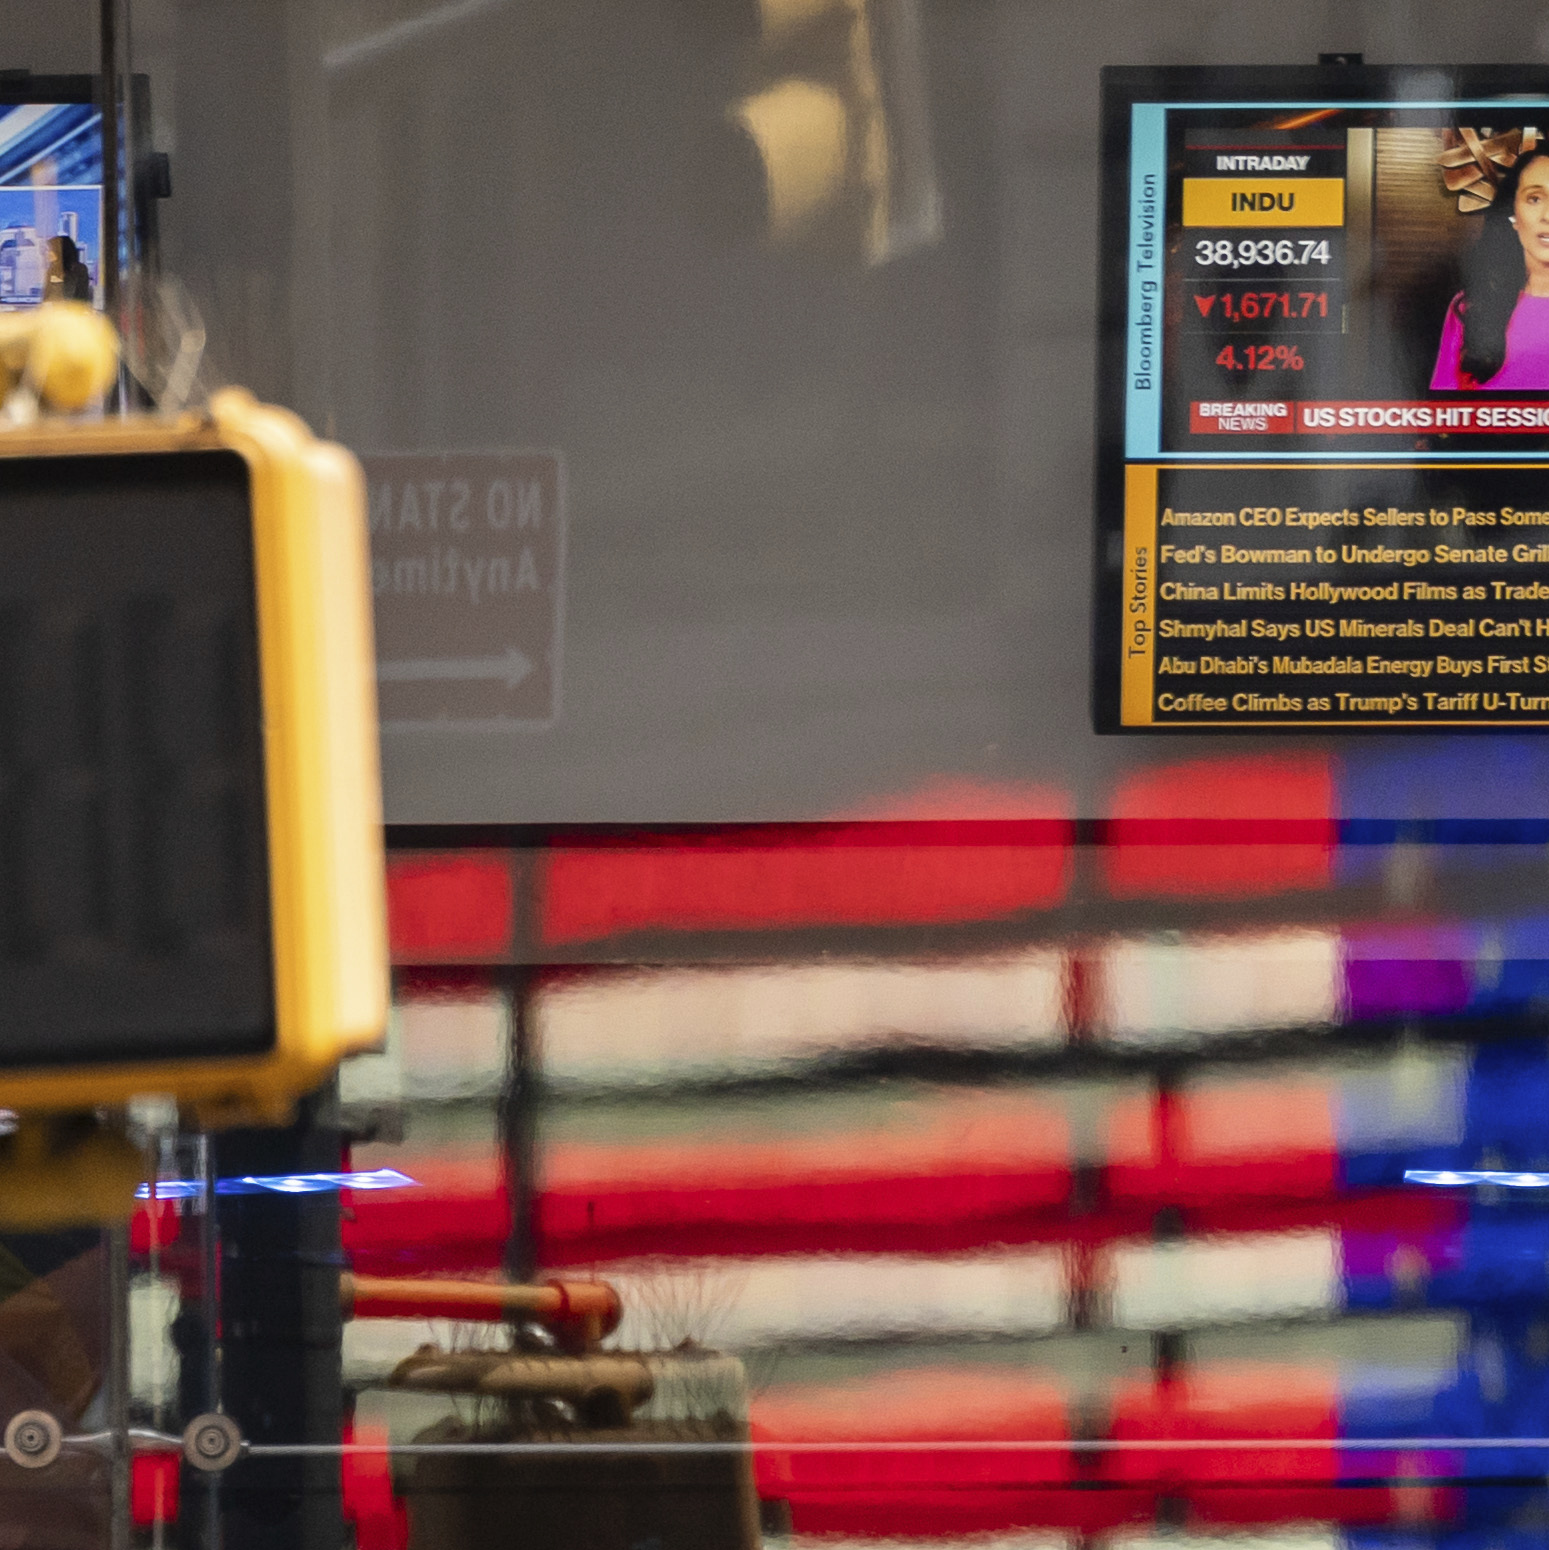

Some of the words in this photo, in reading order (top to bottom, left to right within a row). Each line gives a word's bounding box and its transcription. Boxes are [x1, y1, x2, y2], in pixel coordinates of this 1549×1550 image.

[1216, 155, 1309, 171] INTRADAY
[1231, 192, 1295, 212] INDU
[1136, 174, 1156, 272] Television
[1194, 240, 1331, 268] 38,936.74
[1222, 293, 1329, 321] 1,671.71
[1134, 280, 1158, 390] Bloomberg
[1216, 345, 1305, 371] 4.12%
[1199, 403, 1287, 417] BREAKING
[1303, 408, 1334, 427] US
[1339, 408, 1433, 427] STOCKS
[1435, 408, 1475, 427] HIT
[1217, 417, 1268, 431] NEWS
[1160, 508, 1236, 526] Amazon
[1239, 508, 1281, 526] CEO
[1285, 508, 1359, 529] Expects
[1363, 508, 1425, 526] Sellers
[1429, 509, 1449, 526] to
[1452, 508, 1496, 525] Pass
[1160, 545, 1216, 563] Fed's
[1220, 545, 1311, 563] Bowman
[1316, 546, 1337, 563] to
[1341, 545, 1431, 566] Undergo
[1434, 545, 1508, 563] Senate
[1129, 546, 1147, 614] Stories
[1160, 582, 1218, 600] China
[1223, 582, 1285, 600] Limits
[1290, 582, 1399, 603] Hollywood
[1403, 582, 1457, 600] Films
[1462, 586, 1486, 599] as
[1129, 620, 1149, 659] Top
[1159, 619, 1247, 640] Shmyhal
[1251, 619, 1300, 640] Says
[1305, 619, 1335, 637] US
[1339, 619, 1425, 637] Minerals
[1429, 619, 1475, 637] Deal
[1479, 619, 1532, 636] Can't
[1158, 656, 1197, 674] Abu
[1200, 655, 1269, 674] Dhabi's
[1272, 656, 1363, 674] Mubadala
[1366, 655, 1435, 677] Energy
[1437, 655, 1483, 677] Buys
[1487, 655, 1531, 673] First
[1158, 692, 1228, 711] Coffee
[1232, 692, 1302, 711] Climbs
[1306, 697, 1331, 711] as
[1335, 692, 1418, 713] Trump's
[1423, 691, 1479, 711] Tariff
